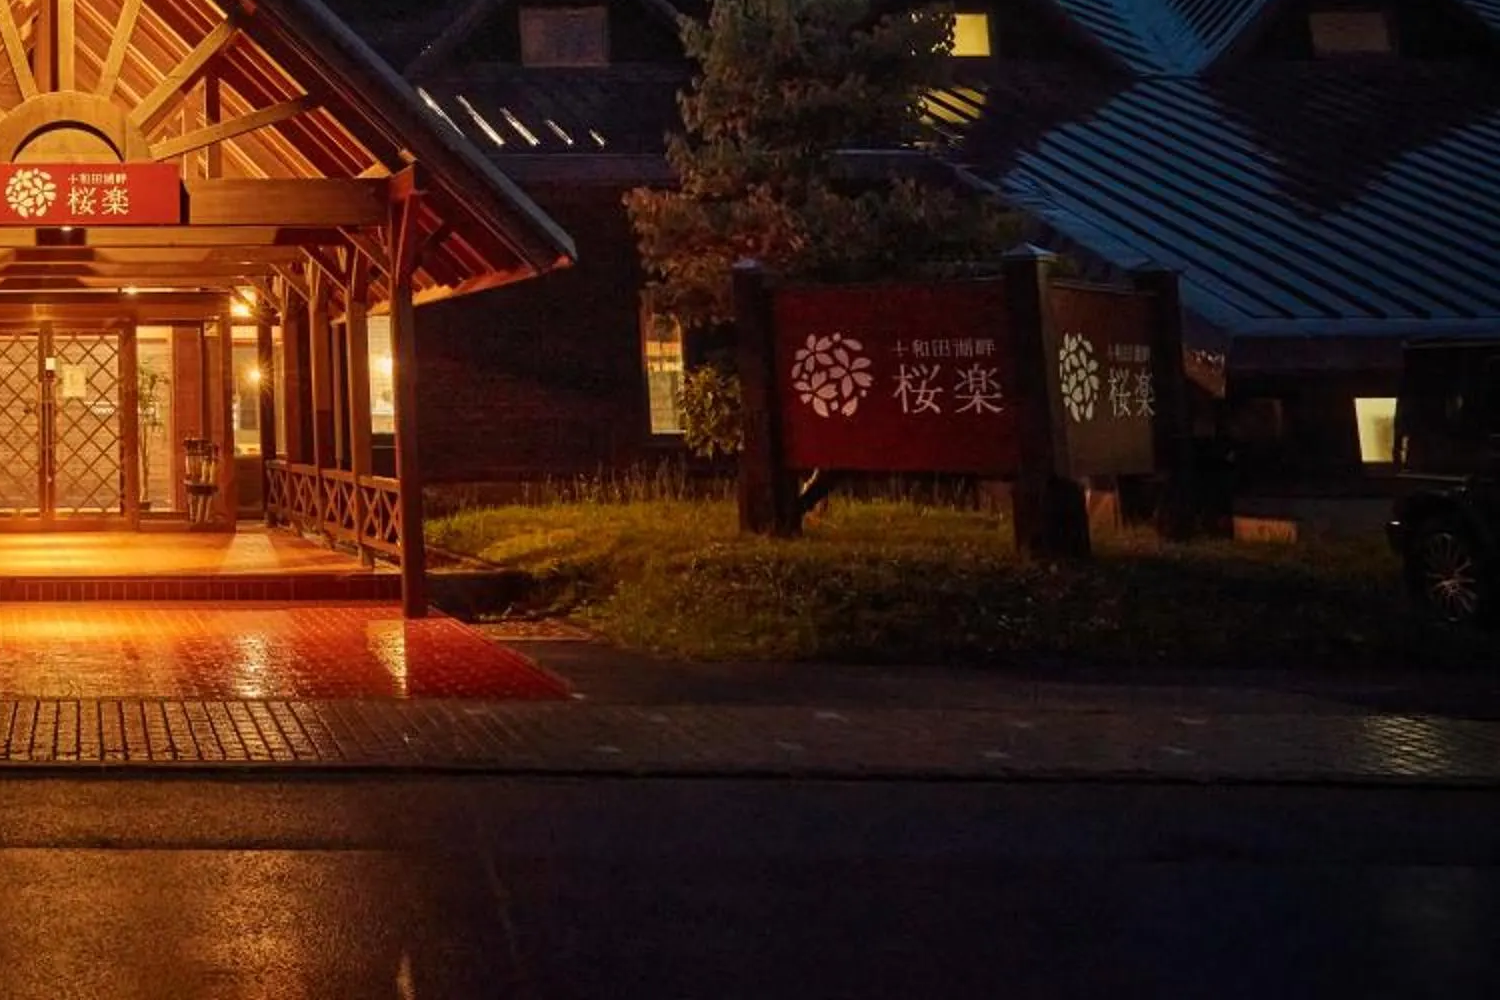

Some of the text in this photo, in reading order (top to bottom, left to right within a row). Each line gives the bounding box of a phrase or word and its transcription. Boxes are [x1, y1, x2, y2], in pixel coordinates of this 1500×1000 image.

[67, 186, 129, 215] 桜楽
[891, 363, 1004, 414] 桜楽
[1107, 367, 1156, 417] 桜楽
